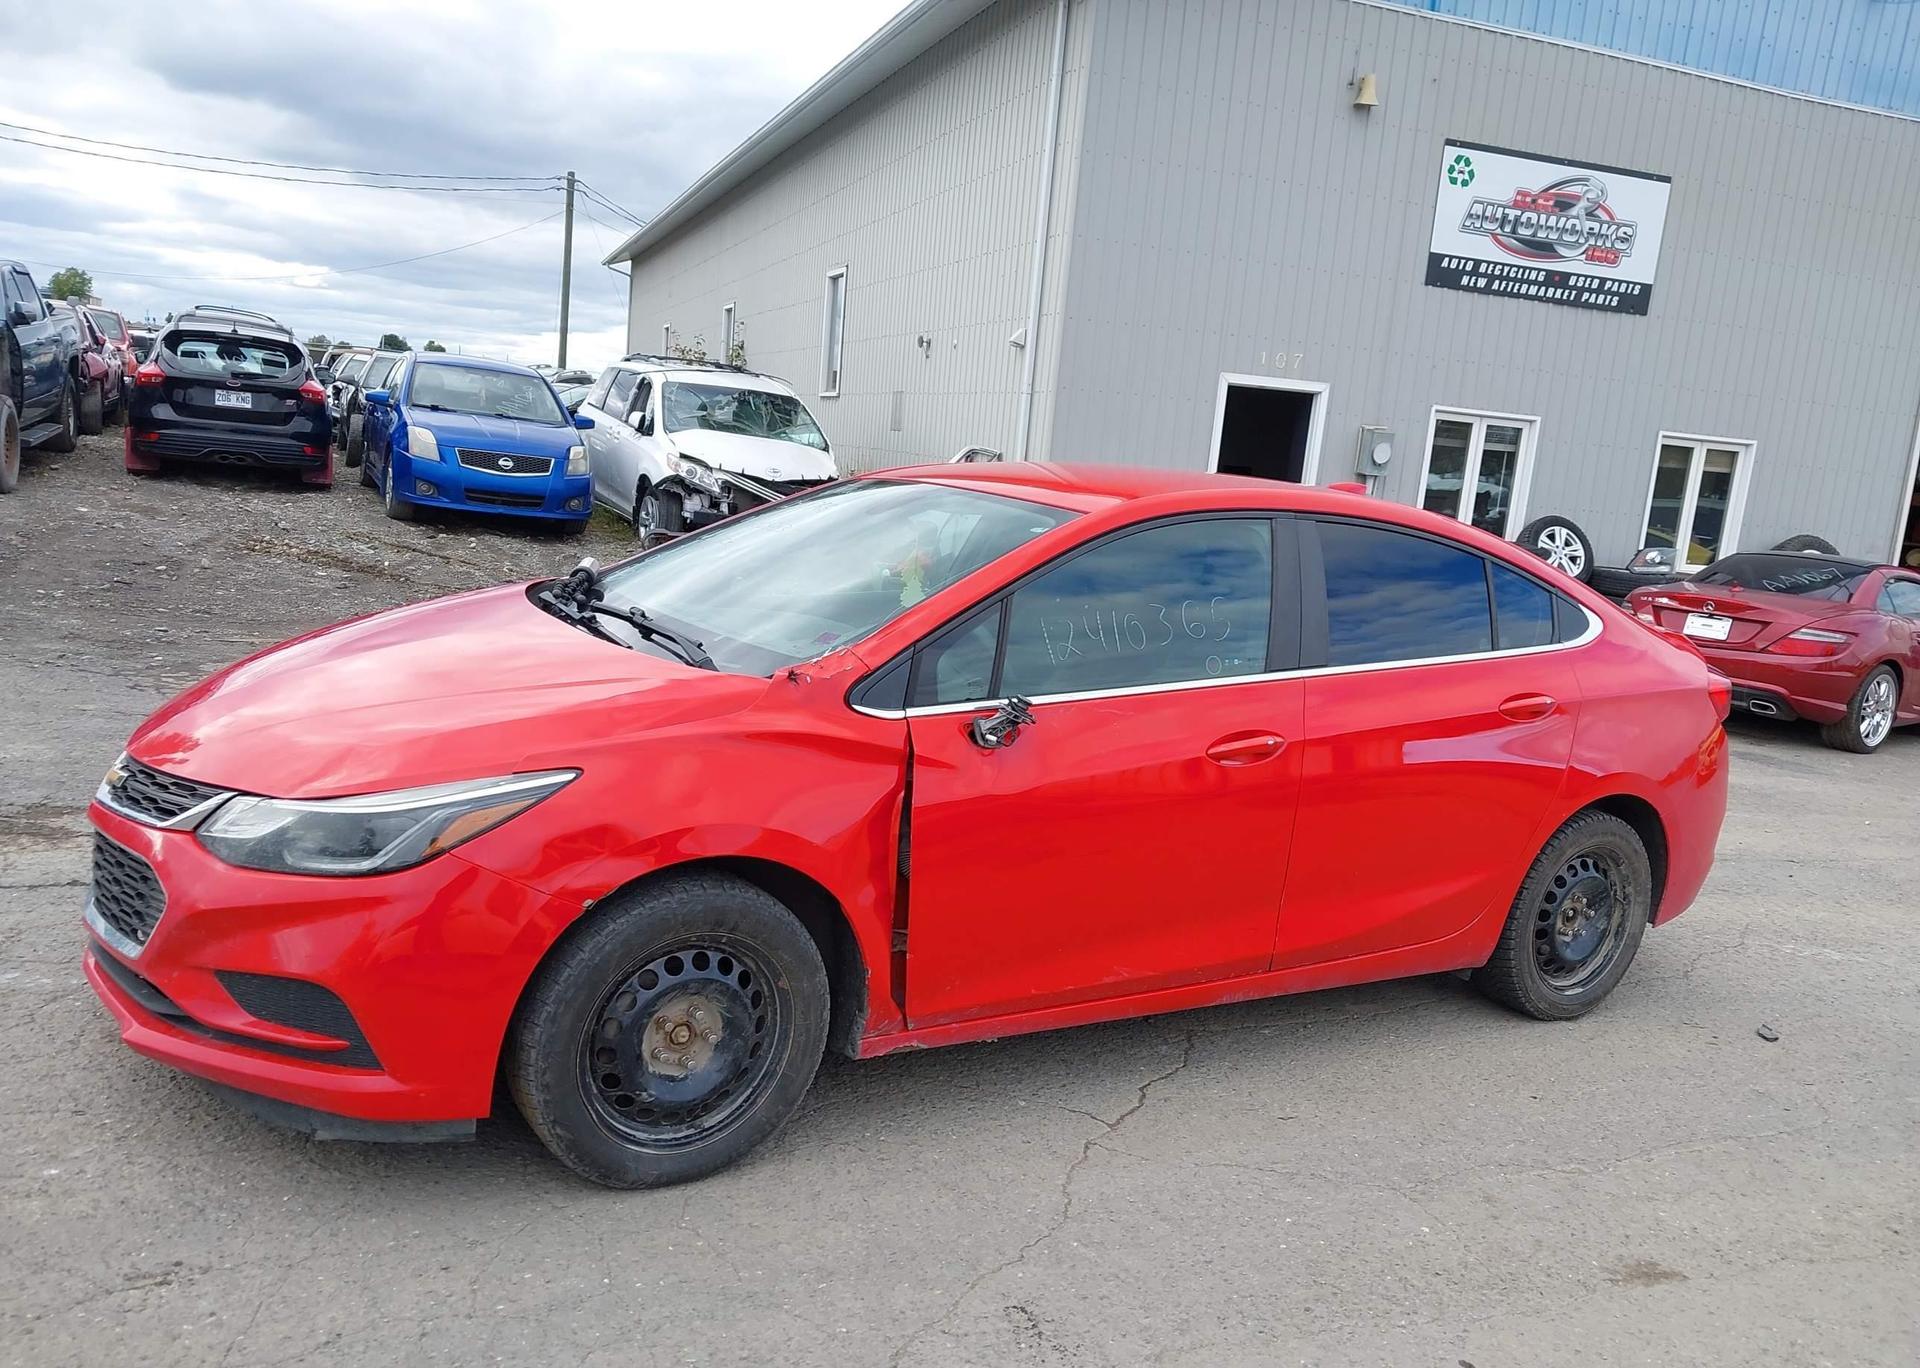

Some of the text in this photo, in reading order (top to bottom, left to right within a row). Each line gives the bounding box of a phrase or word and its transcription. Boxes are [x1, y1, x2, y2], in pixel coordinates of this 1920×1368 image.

[1463, 202, 1634, 251] AUTOWORKS
[1441, 256, 1641, 295] AUTO RECYCLING USED PARTS
[1460, 275, 1619, 307] NEW AFTERMARKET PARTS
[1260, 351, 1304, 369] 107
[235, 394, 251, 405] KNG
